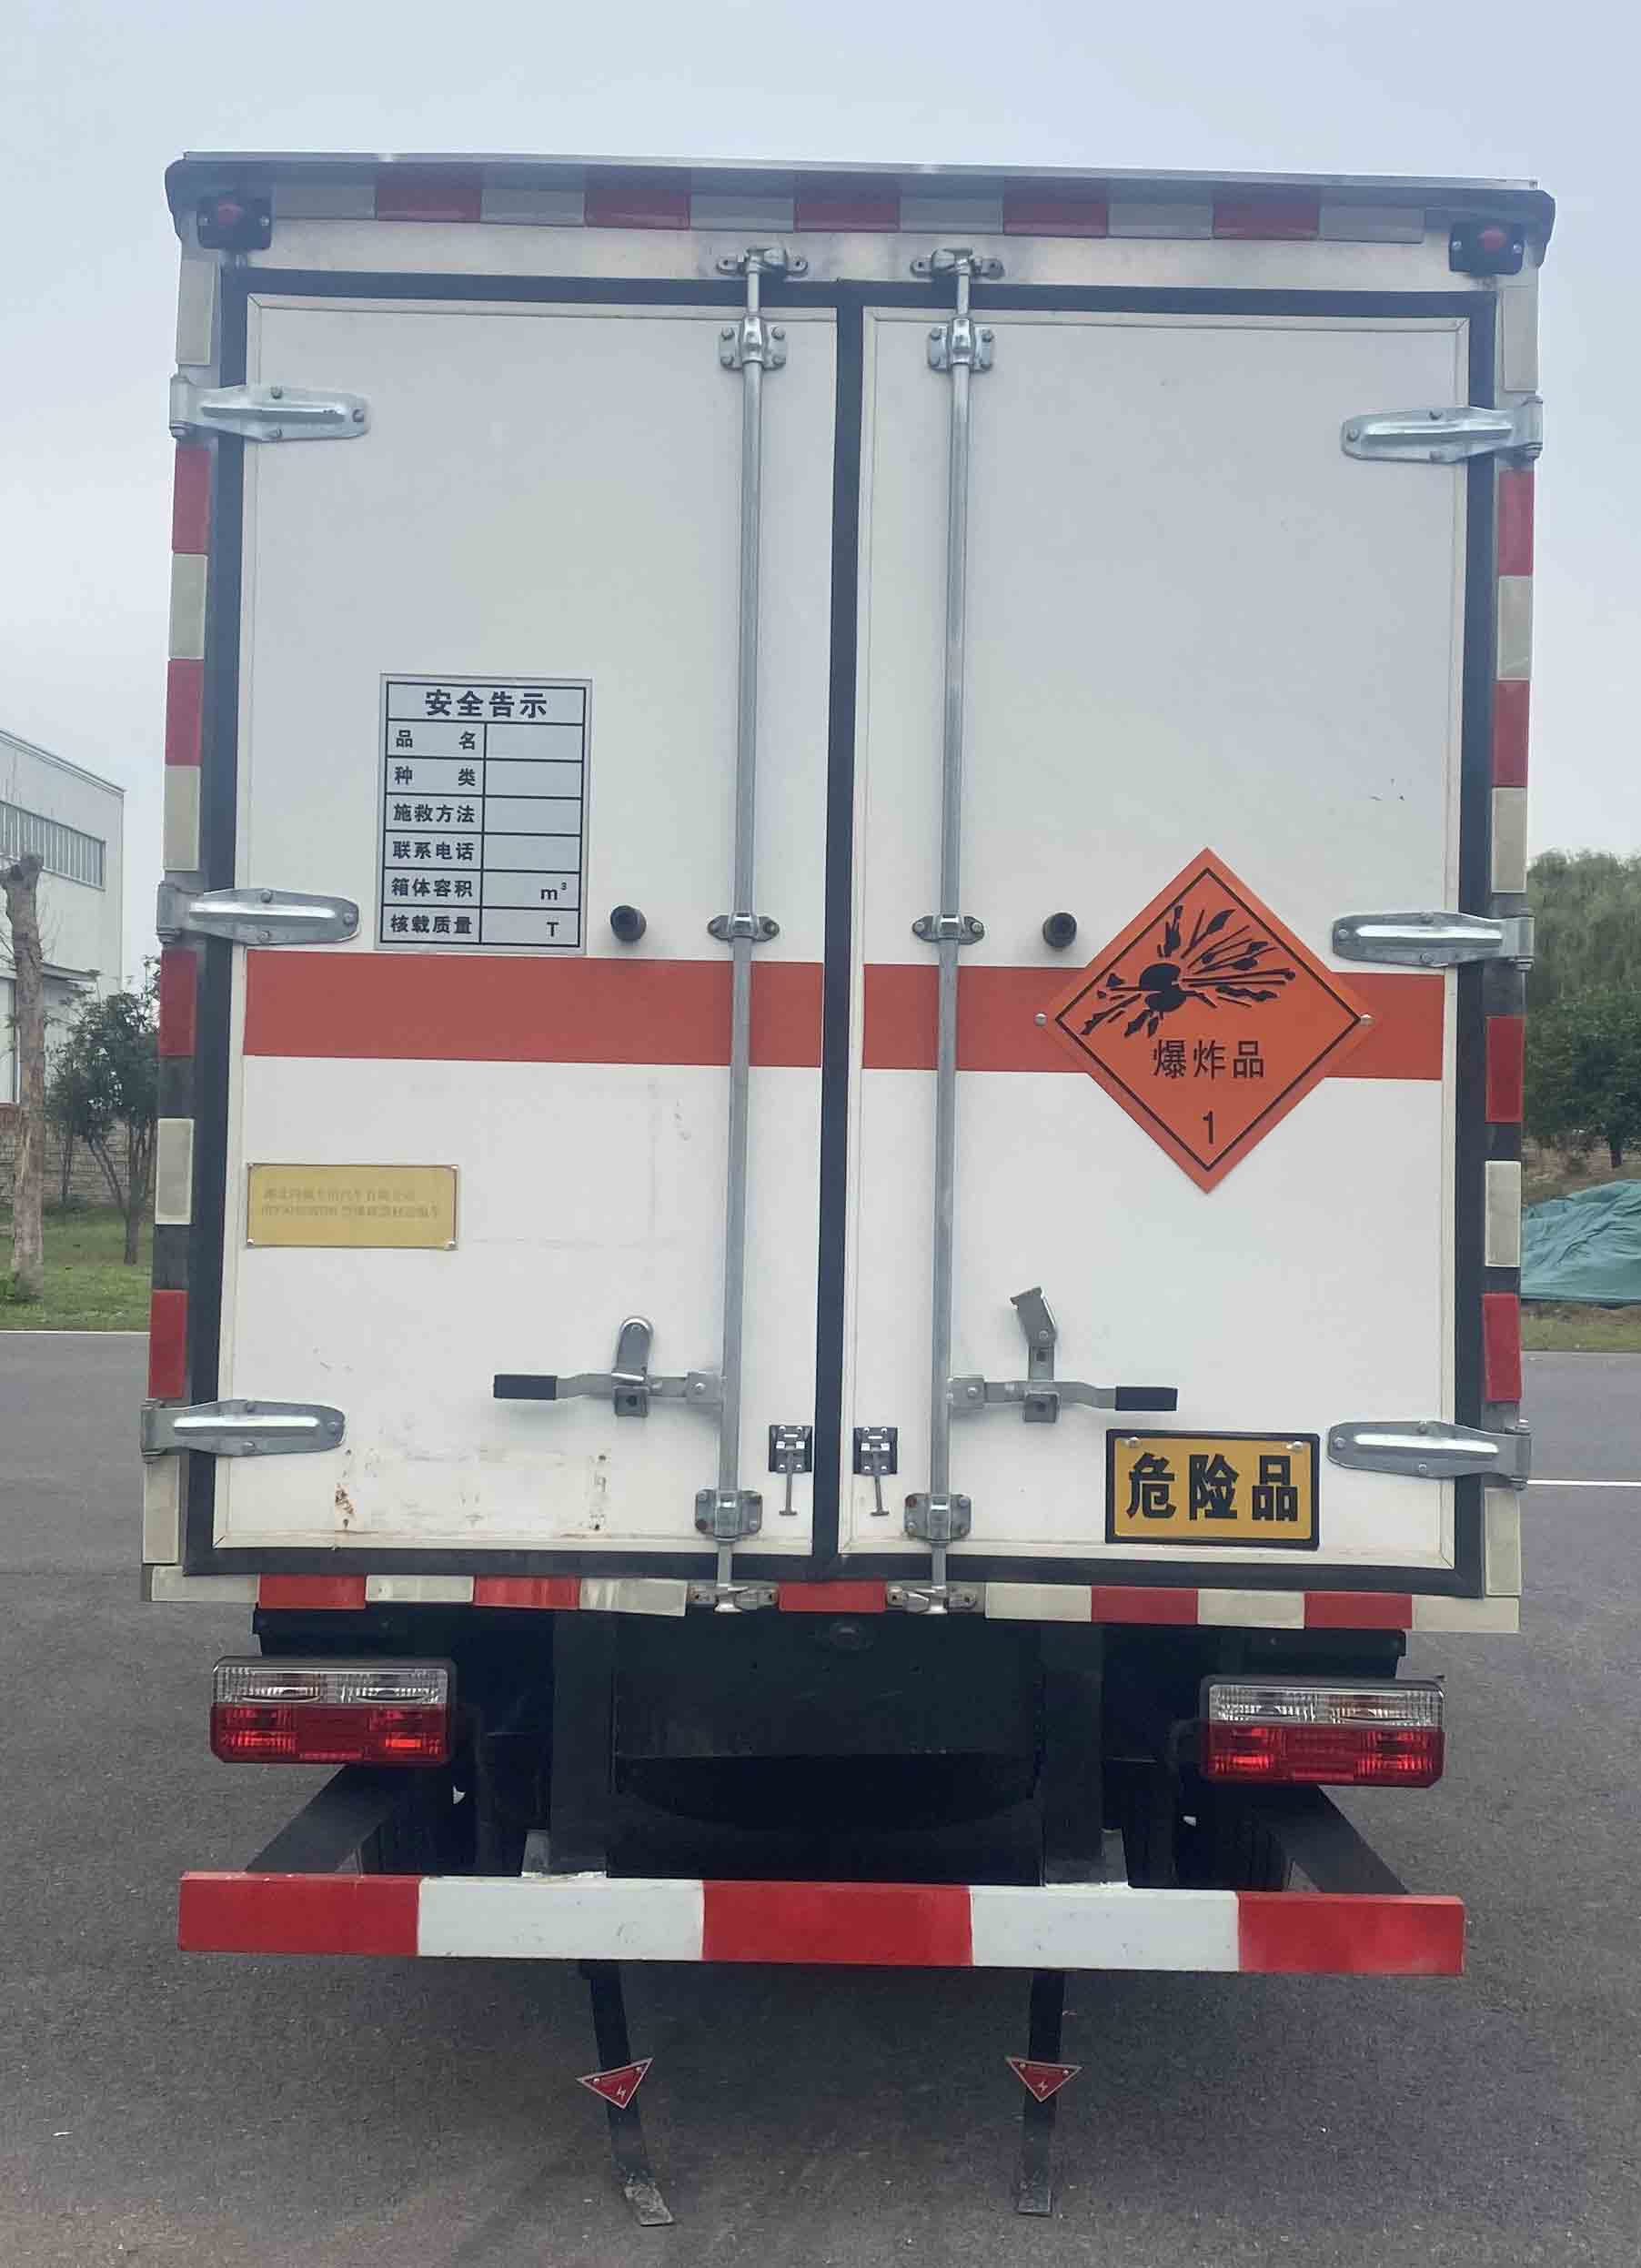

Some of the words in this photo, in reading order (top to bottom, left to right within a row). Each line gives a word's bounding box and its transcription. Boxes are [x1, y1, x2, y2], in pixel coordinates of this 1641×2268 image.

[425, 689, 548, 719] 安全告示
[393, 802, 475, 823] 施救方法
[392, 840, 474, 862] 联系电话
[391, 877, 473, 899] 箱体容积
[390, 913, 472, 935] 核载质量
[547, 922, 559, 938] T
[1152, 1039, 1264, 1080] 爆炸品
[1202, 1110, 1214, 1144] 1
[1126, 1452, 1299, 1522] 危险品
